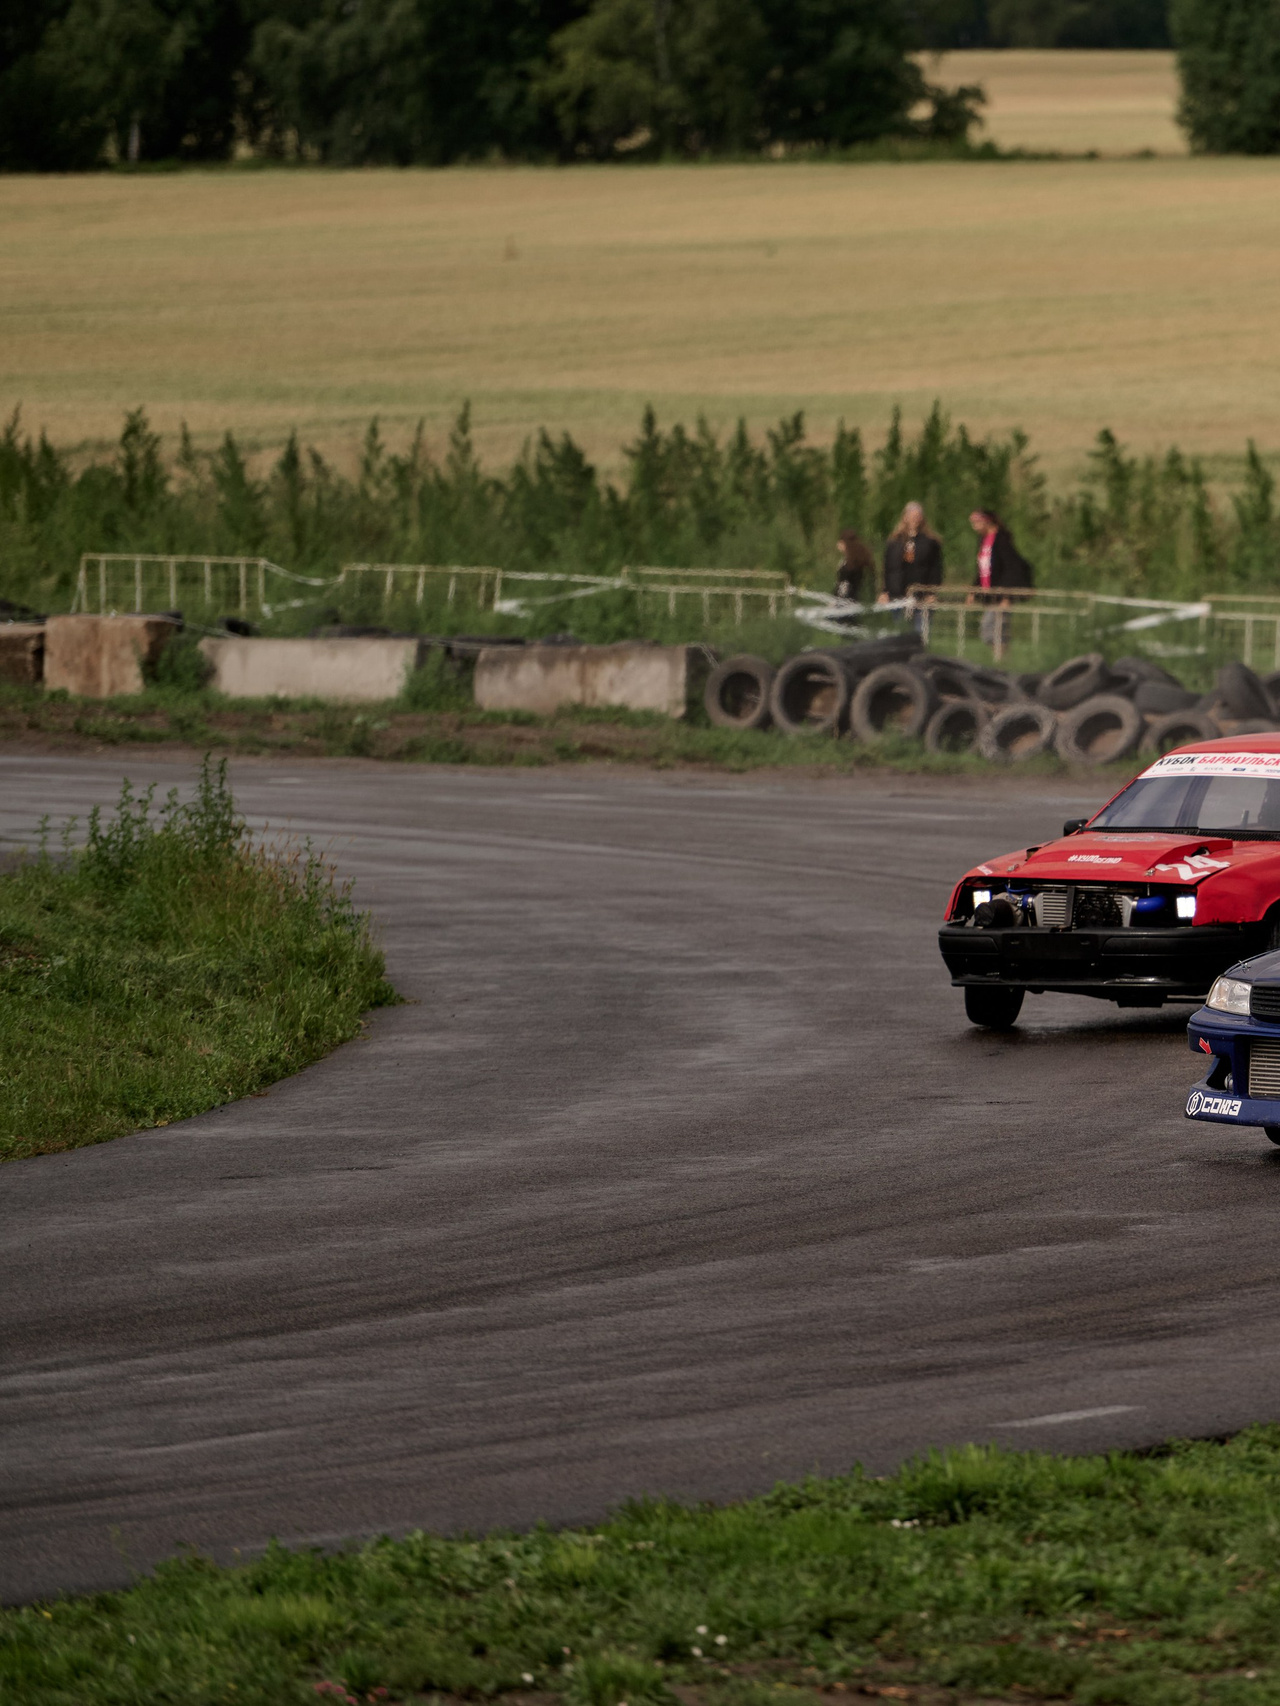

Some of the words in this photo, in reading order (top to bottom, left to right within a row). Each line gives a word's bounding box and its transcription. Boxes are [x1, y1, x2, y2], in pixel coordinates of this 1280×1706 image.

[1156, 756, 1199, 767] КУБОК
[1155, 855, 1231, 881] 24
[1201, 1099, 1242, 1116] СОЮЗ
